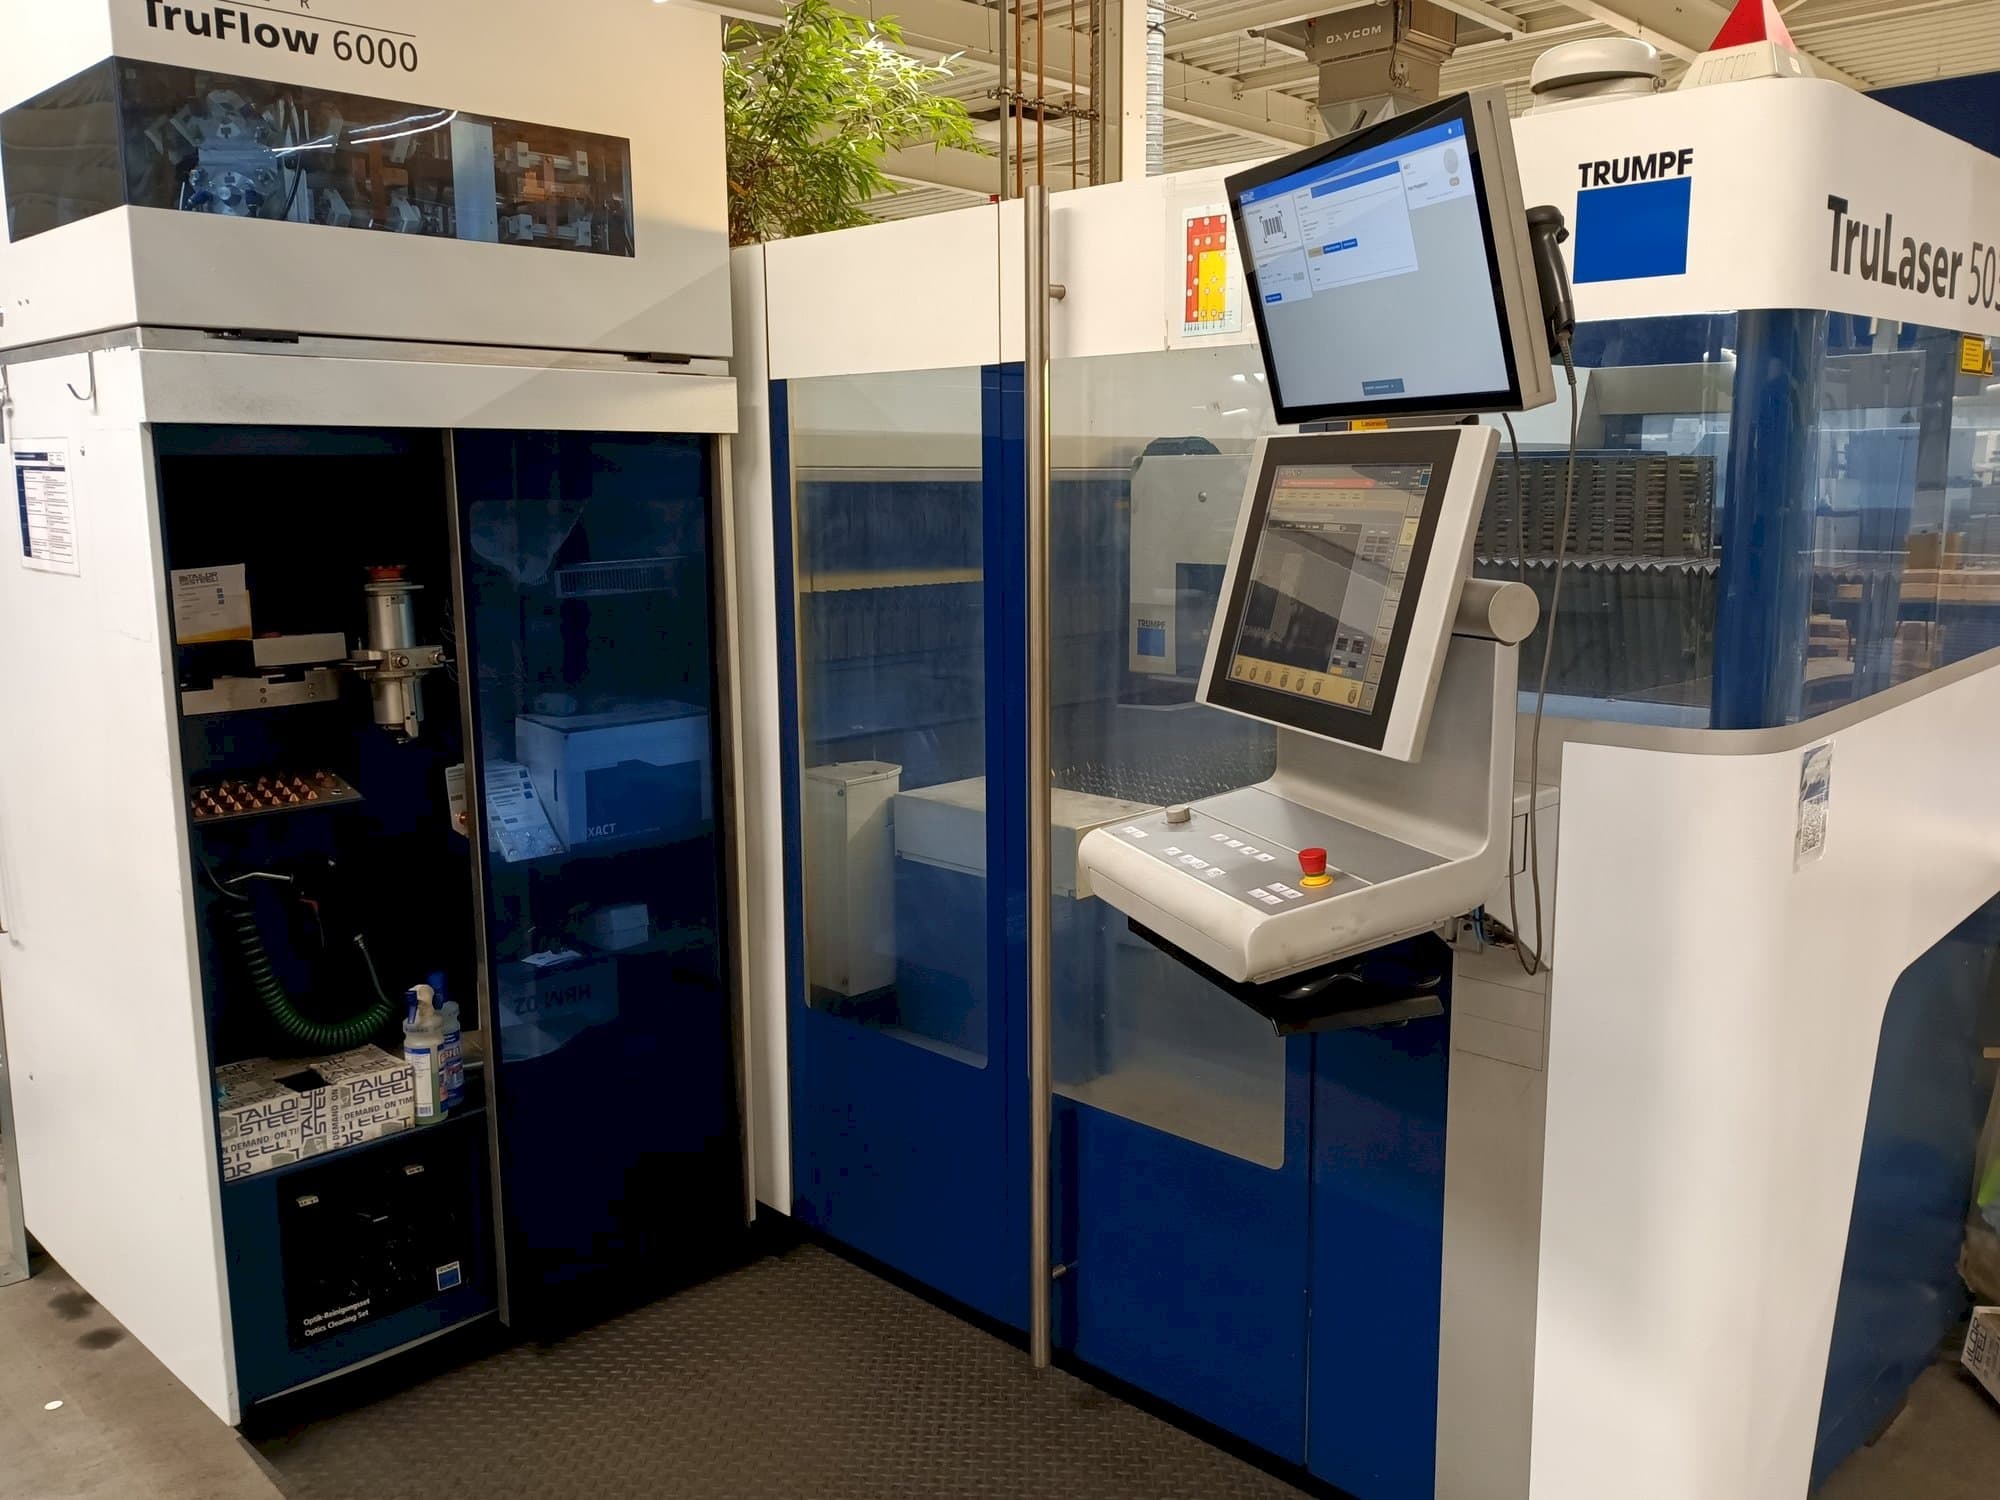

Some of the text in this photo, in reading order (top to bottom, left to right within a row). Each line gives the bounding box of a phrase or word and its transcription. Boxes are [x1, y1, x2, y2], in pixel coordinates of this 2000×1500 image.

[146, 0, 418, 72] TruFlow 6000
[1326, 25, 1382, 44] OXYCOM
[1578, 148, 1694, 188] TRUMPF
[1828, 194, 1963, 300] TruLaser
[1137, 619, 1166, 629] TRUMPF
[347, 1066, 415, 1093] TAILOR
[352, 1081, 413, 1106] STEEL
[344, 1104, 380, 1120] DEMAND
[384, 1100, 397, 1109] ON
[230, 1135, 270, 1152] DEMAND
[274, 1131, 287, 1140] ON
[304, 1309, 369, 1337] Optics Cleaning Set
